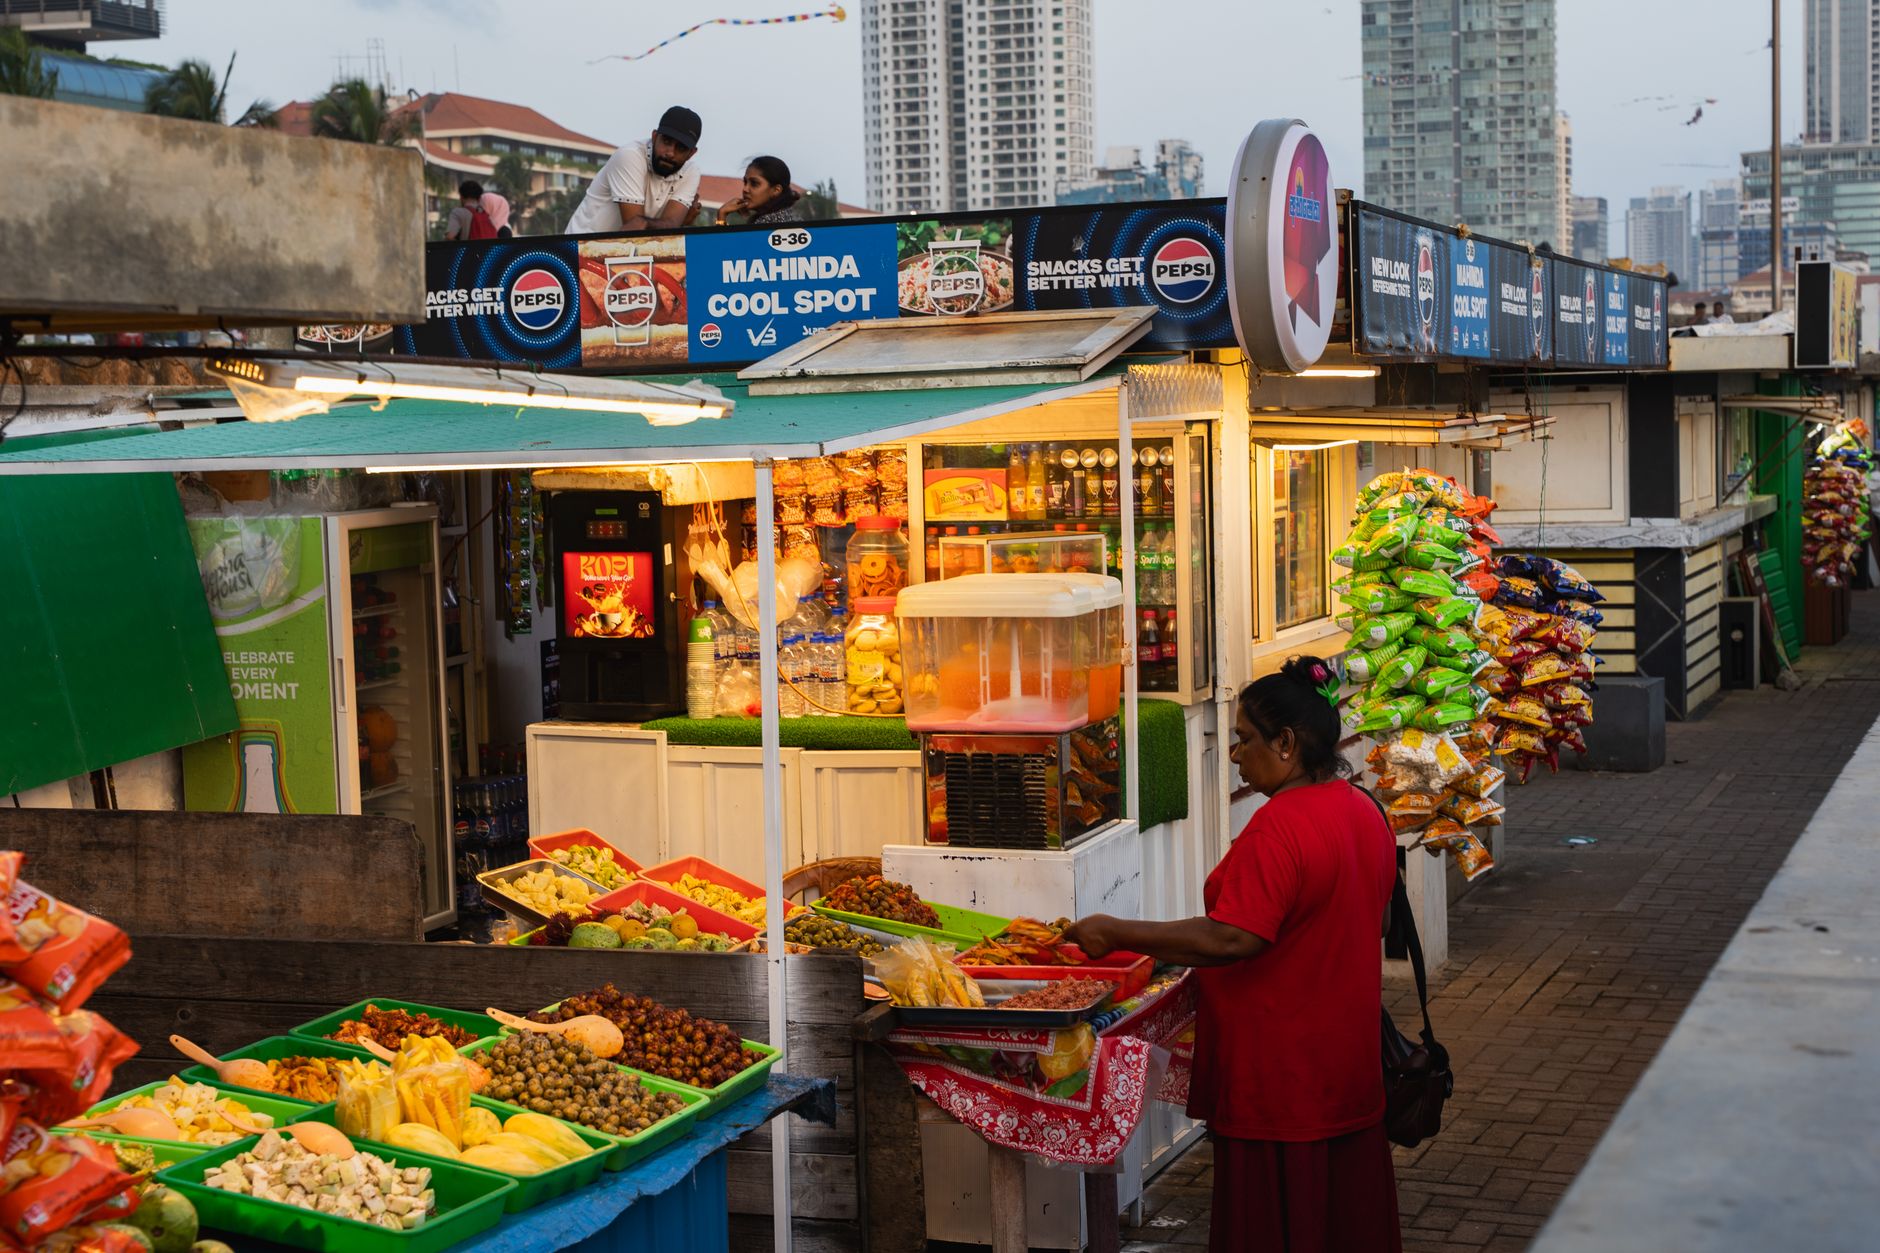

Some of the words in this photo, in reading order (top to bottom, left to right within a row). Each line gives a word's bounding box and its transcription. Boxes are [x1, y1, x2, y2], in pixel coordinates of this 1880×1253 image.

[771, 232, 808, 246] B-36
[722, 254, 860, 284] MAHINDA
[1027, 258, 1103, 276] SNACKS
[1105, 256, 1145, 273] GET
[1156, 262, 1211, 278] PEPSI
[1371, 256, 1389, 278] NEW
[1389, 260, 1411, 282] LOOK
[931, 277, 980, 291] PEPSI
[1027, 274, 1097, 291] BETTER
[1099, 272, 1145, 288] WITH
[1456, 263, 1484, 289] MAHINDA
[426, 288, 468, 305] ACKS
[470, 286, 505, 302] GET
[514, 293, 561, 307] PEPSI
[607, 292, 653, 306] PEPSI
[707, 291, 789, 318] COOL
[793, 287, 877, 315] SPOT
[425, 303, 464, 319] TTER
[465, 301, 505, 317] WITH
[1453, 294, 1471, 318] COOL
[1471, 295, 1488, 319] SPOT
[580, 555, 634, 579] KOPI
[224, 652, 295, 664] ELEBRATE
[232, 667, 277, 680] EVERY
[232, 683, 299, 700] OMENT
